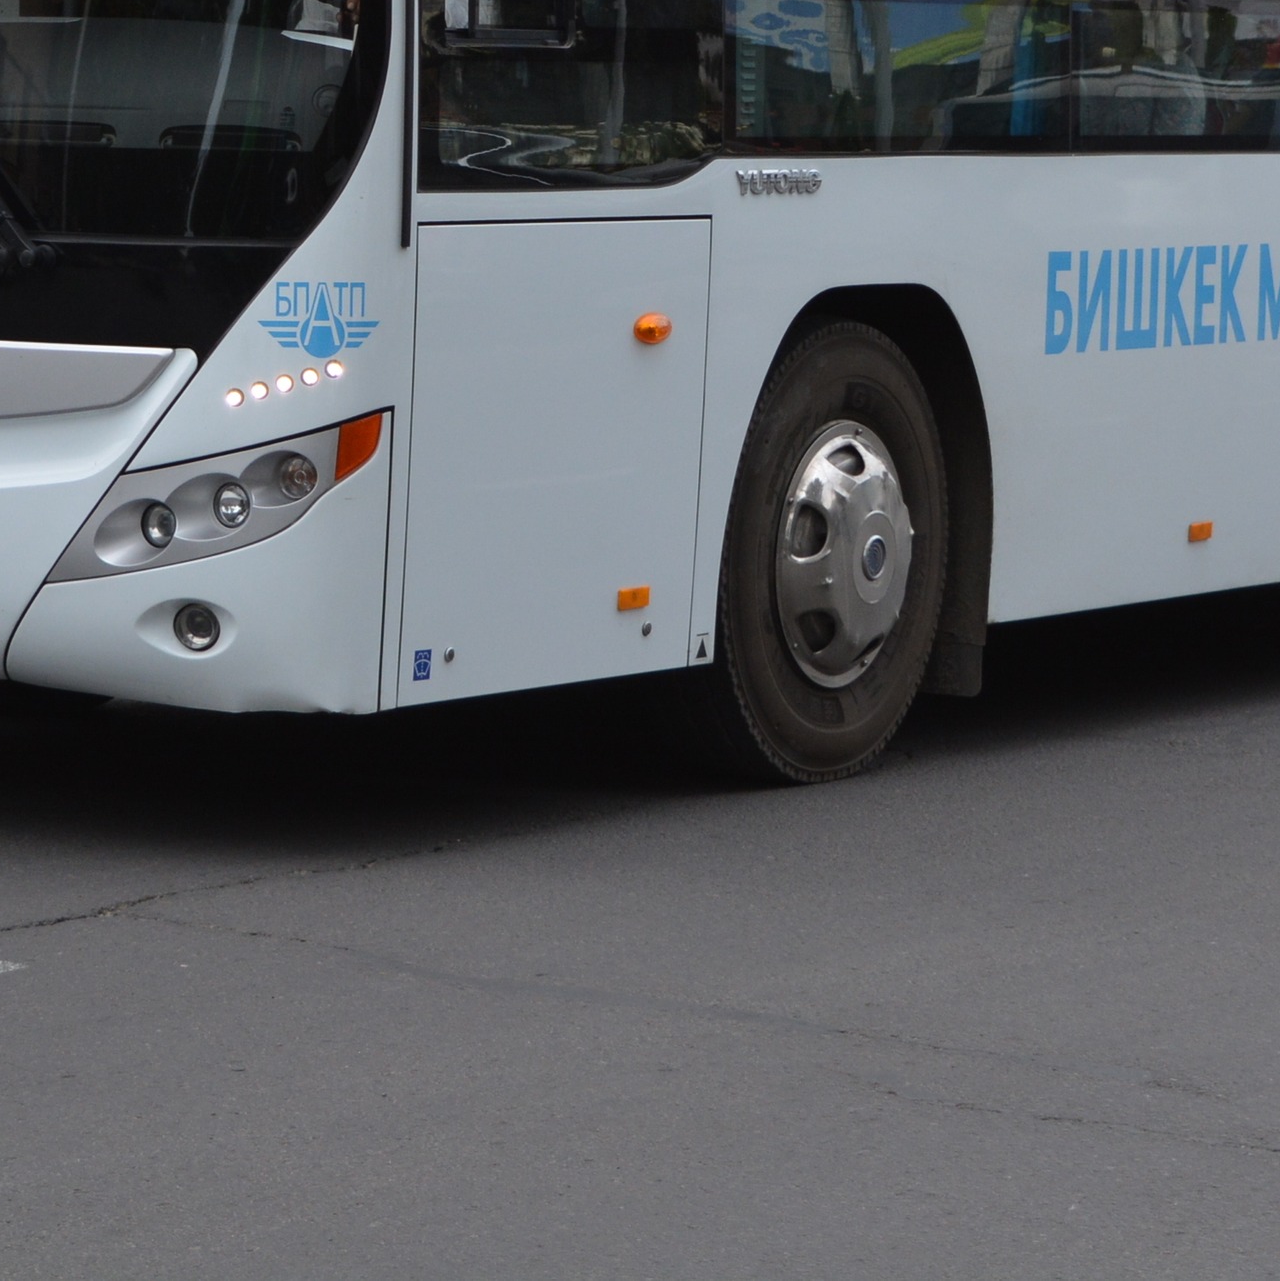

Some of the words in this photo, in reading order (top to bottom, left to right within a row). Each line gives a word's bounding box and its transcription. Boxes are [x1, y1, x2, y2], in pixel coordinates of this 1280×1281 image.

[735, 168, 823, 196] YUTONG
[275, 281, 366, 347] БПАТП
[1045, 244, 1248, 355] БИШКЕК
